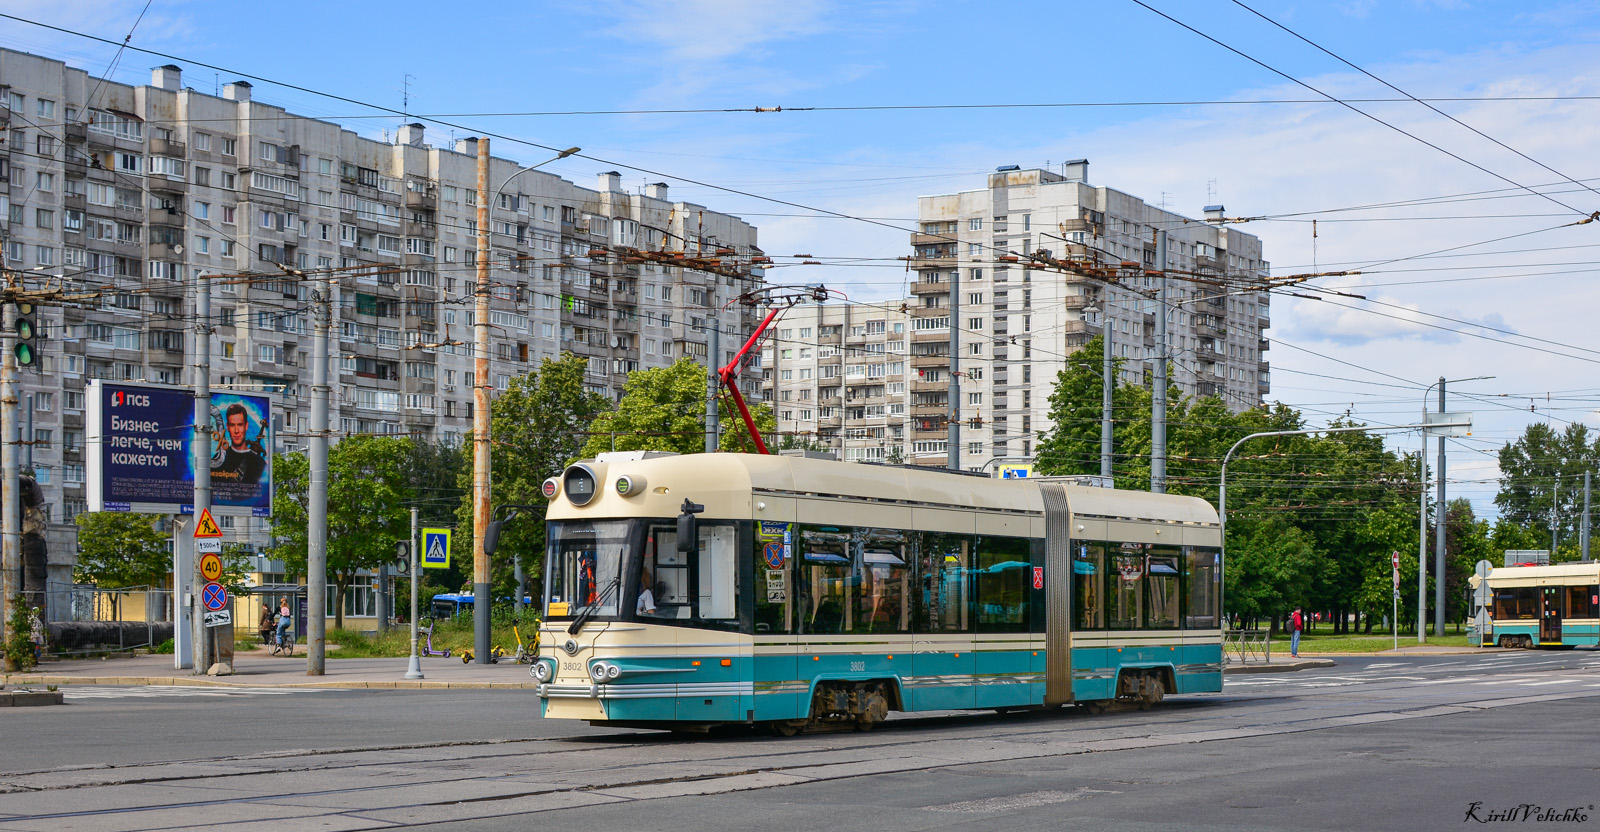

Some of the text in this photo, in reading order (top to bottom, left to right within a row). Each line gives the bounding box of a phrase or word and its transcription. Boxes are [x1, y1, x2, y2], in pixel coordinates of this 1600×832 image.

[126, 394, 150, 407] ПСБ
[111, 415, 160, 433] Бизнес
[111, 435, 182, 452] легче, чем
[111, 452, 168, 467] кажется
[205, 561, 218, 573] 40
[563, 662, 582, 671] 3802
[850, 661, 865, 672] 3802
